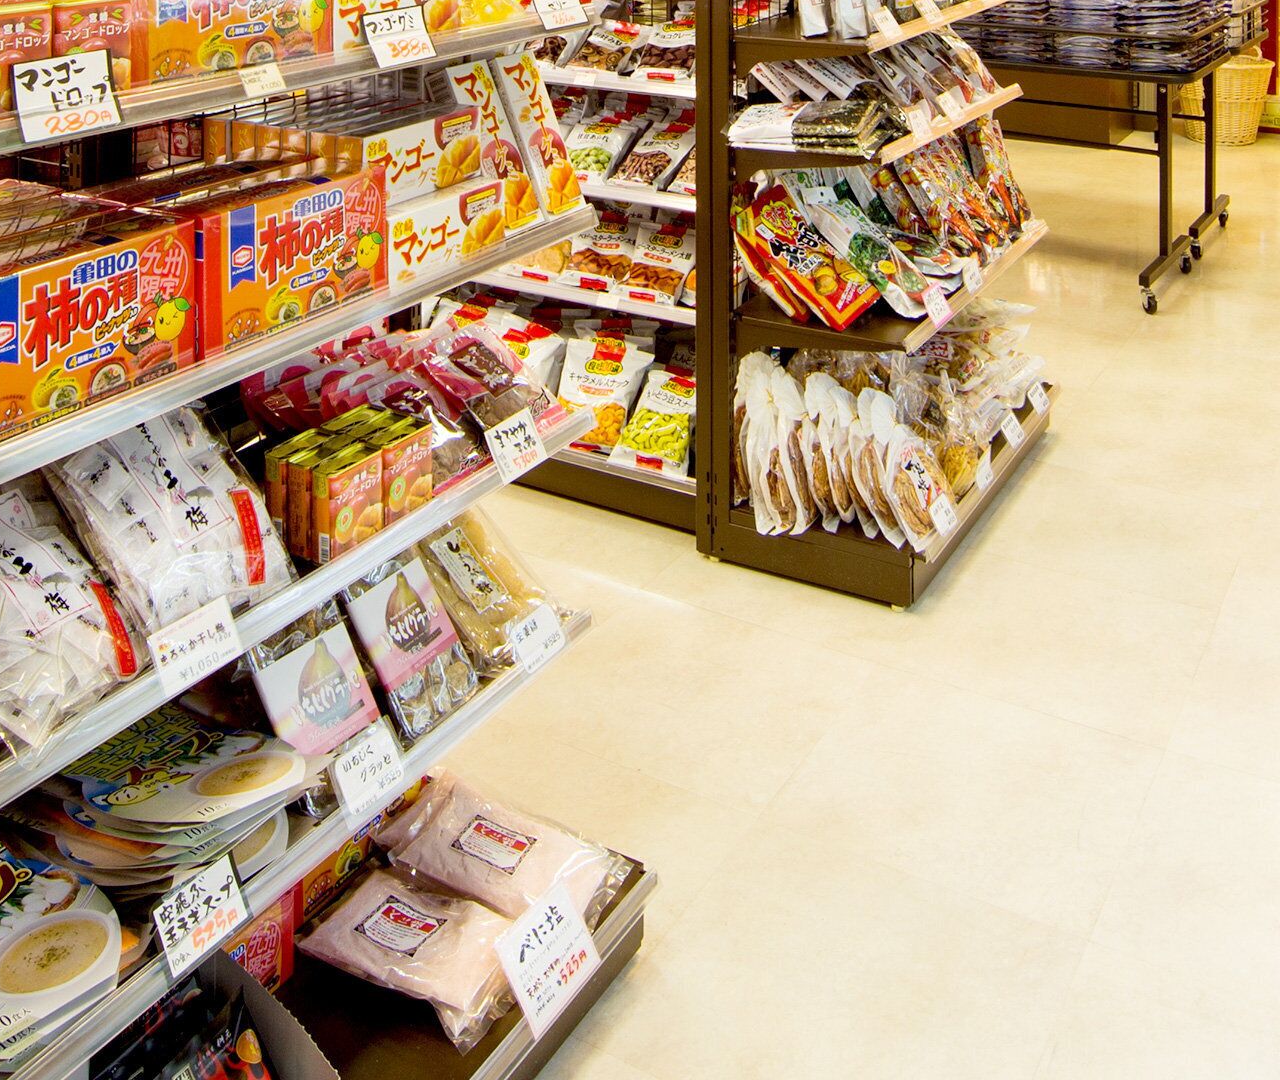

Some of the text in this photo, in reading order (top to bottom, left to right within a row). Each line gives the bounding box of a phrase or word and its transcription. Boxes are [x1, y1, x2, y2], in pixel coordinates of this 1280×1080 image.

[61, 22, 131, 42] マンゴードロップ
[16, 59, 87, 92] マンゴー
[51, 75, 111, 112] ドロップ
[44, 109, 113, 135] 280円
[453, 72, 521, 182] マンゴーグミ
[503, 62, 566, 169] マンゴーグミ
[293, 188, 345, 218] 亀田の
[141, 245, 184, 275] 九州
[258, 204, 346, 291] 柿の種
[393, 216, 460, 266] マンゴー
[73, 250, 139, 286] 亀田の
[23, 267, 139, 370] 柿の種
[159, 876, 206, 926] 空飛ぶ
[163, 874, 234, 948] 玉ネギスープ
[192, 907, 239, 953] 525円
[519, 904, 565, 963] べに塩
